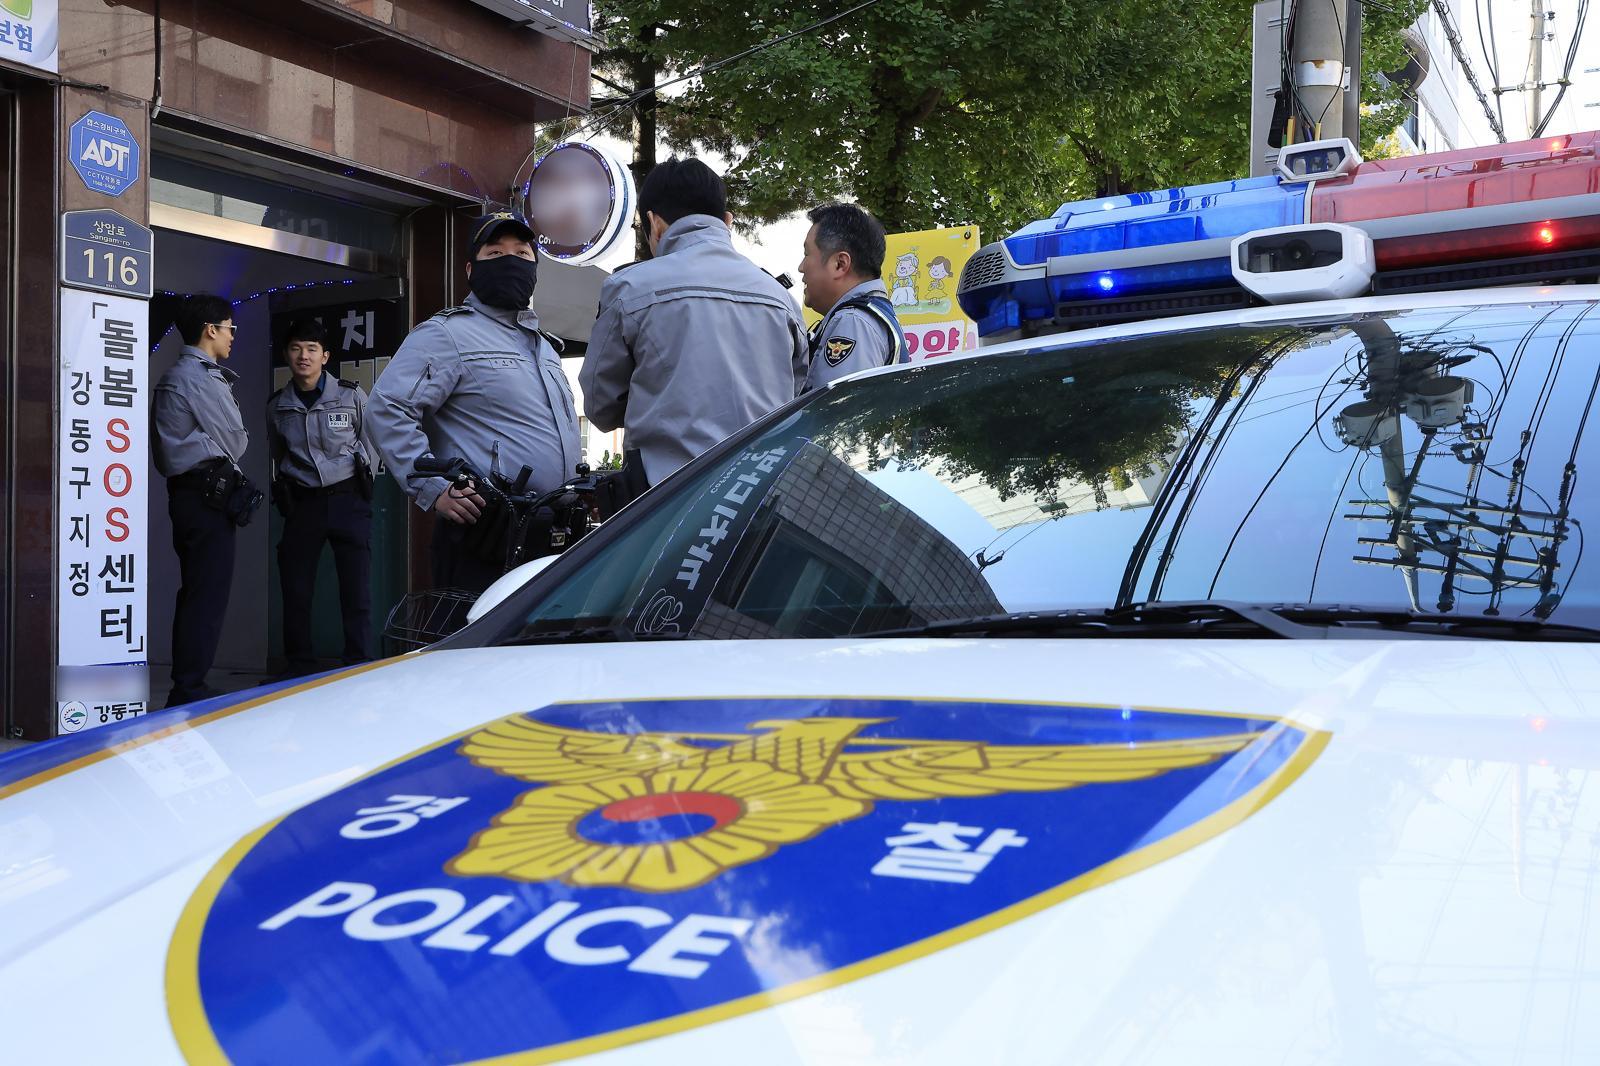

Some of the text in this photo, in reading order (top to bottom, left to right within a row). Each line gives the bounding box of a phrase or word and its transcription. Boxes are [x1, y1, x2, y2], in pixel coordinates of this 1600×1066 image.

[81, 137, 130, 172] ADT
[89, 232, 131, 247] Sangam-ro
[93, 220, 126, 237] 상암로
[83, 248, 139, 287] 116
[93, 701, 144, 723] 강동구
[339, 794, 1029, 885] 경 찰
[257, 881, 754, 980] POLICE
